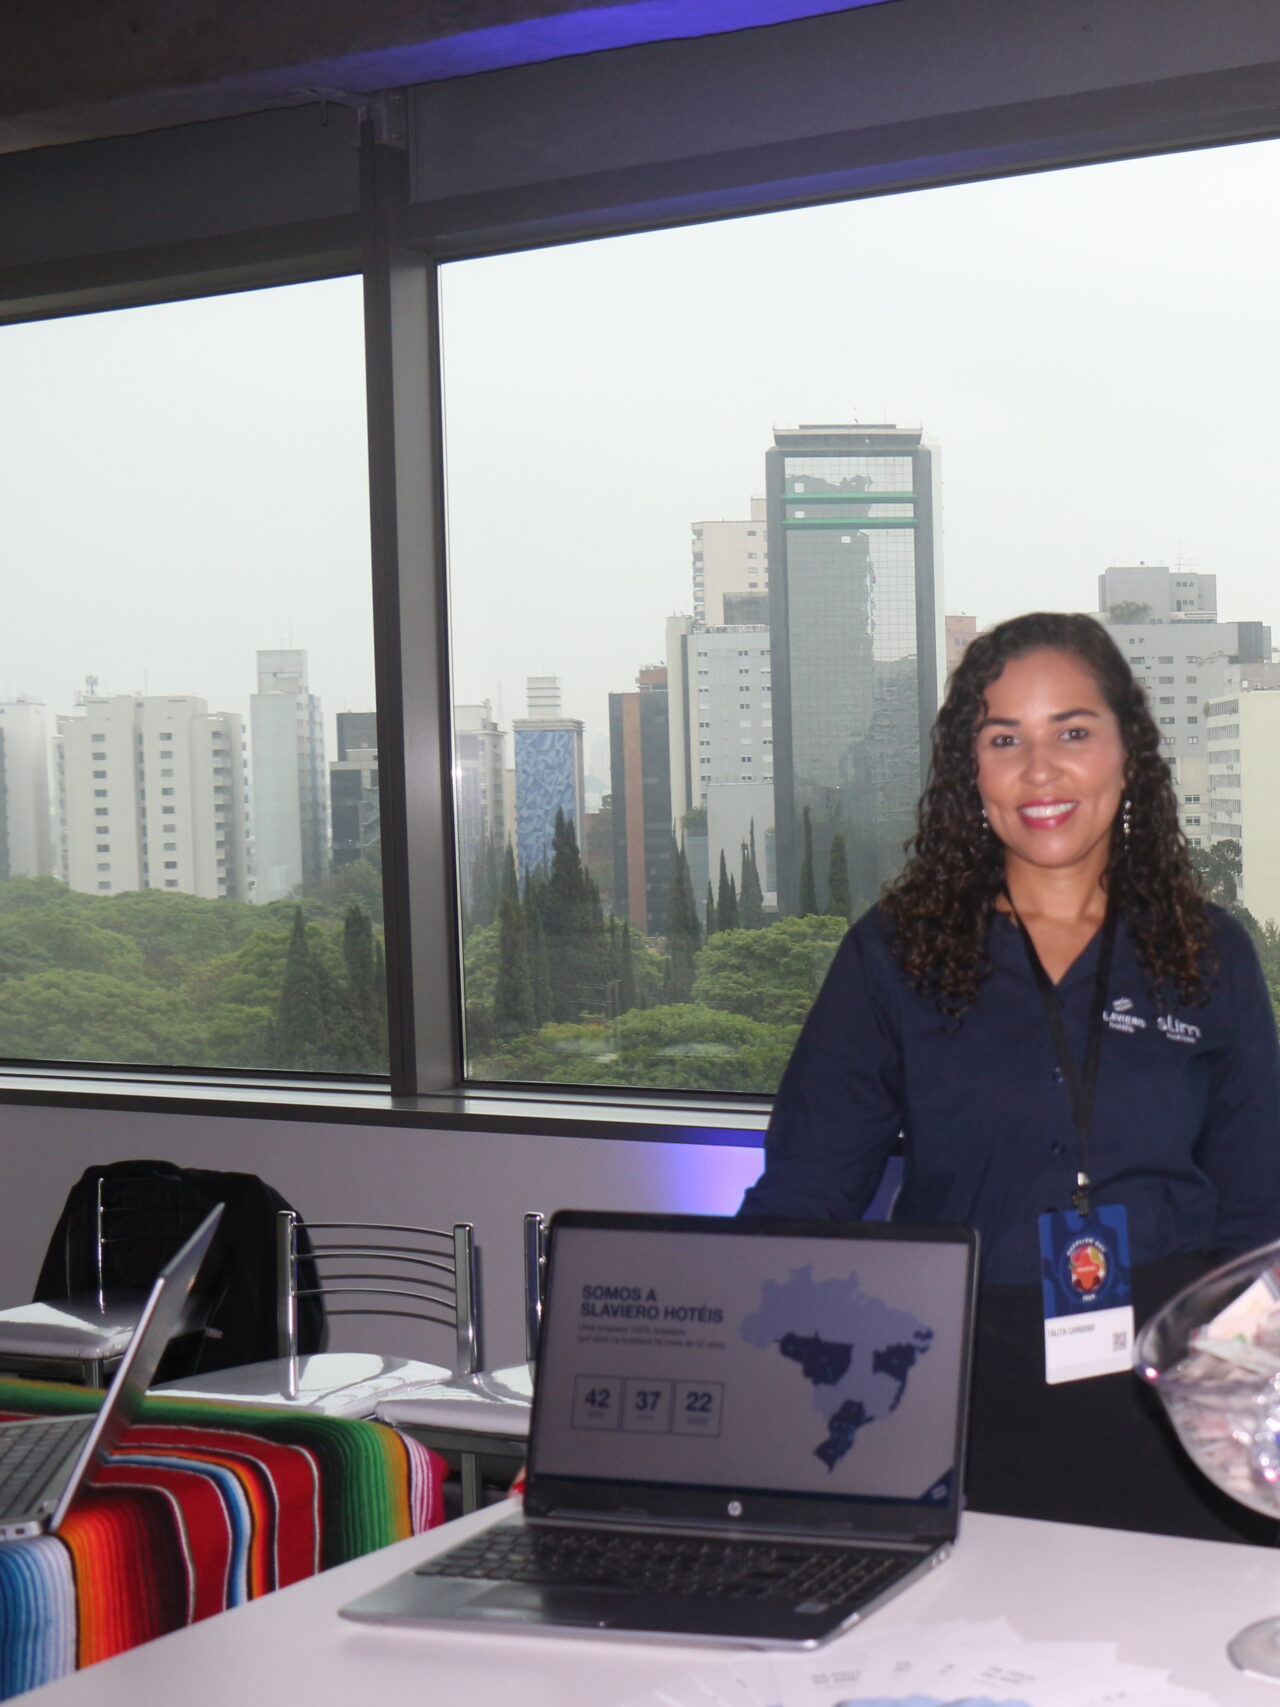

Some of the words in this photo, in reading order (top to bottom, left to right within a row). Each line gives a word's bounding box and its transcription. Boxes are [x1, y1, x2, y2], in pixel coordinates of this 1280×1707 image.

[1156, 1013, 1202, 1038] slim
[582, 1284, 641, 1301] SOMOS
[646, 1287, 657, 1302] A
[580, 1302, 659, 1319] SLAVIERO
[663, 1303, 724, 1323] HOTÉIS
[584, 1387, 611, 1408] 42
[634, 1389, 662, 1411] 37
[685, 1391, 713, 1412] 22
